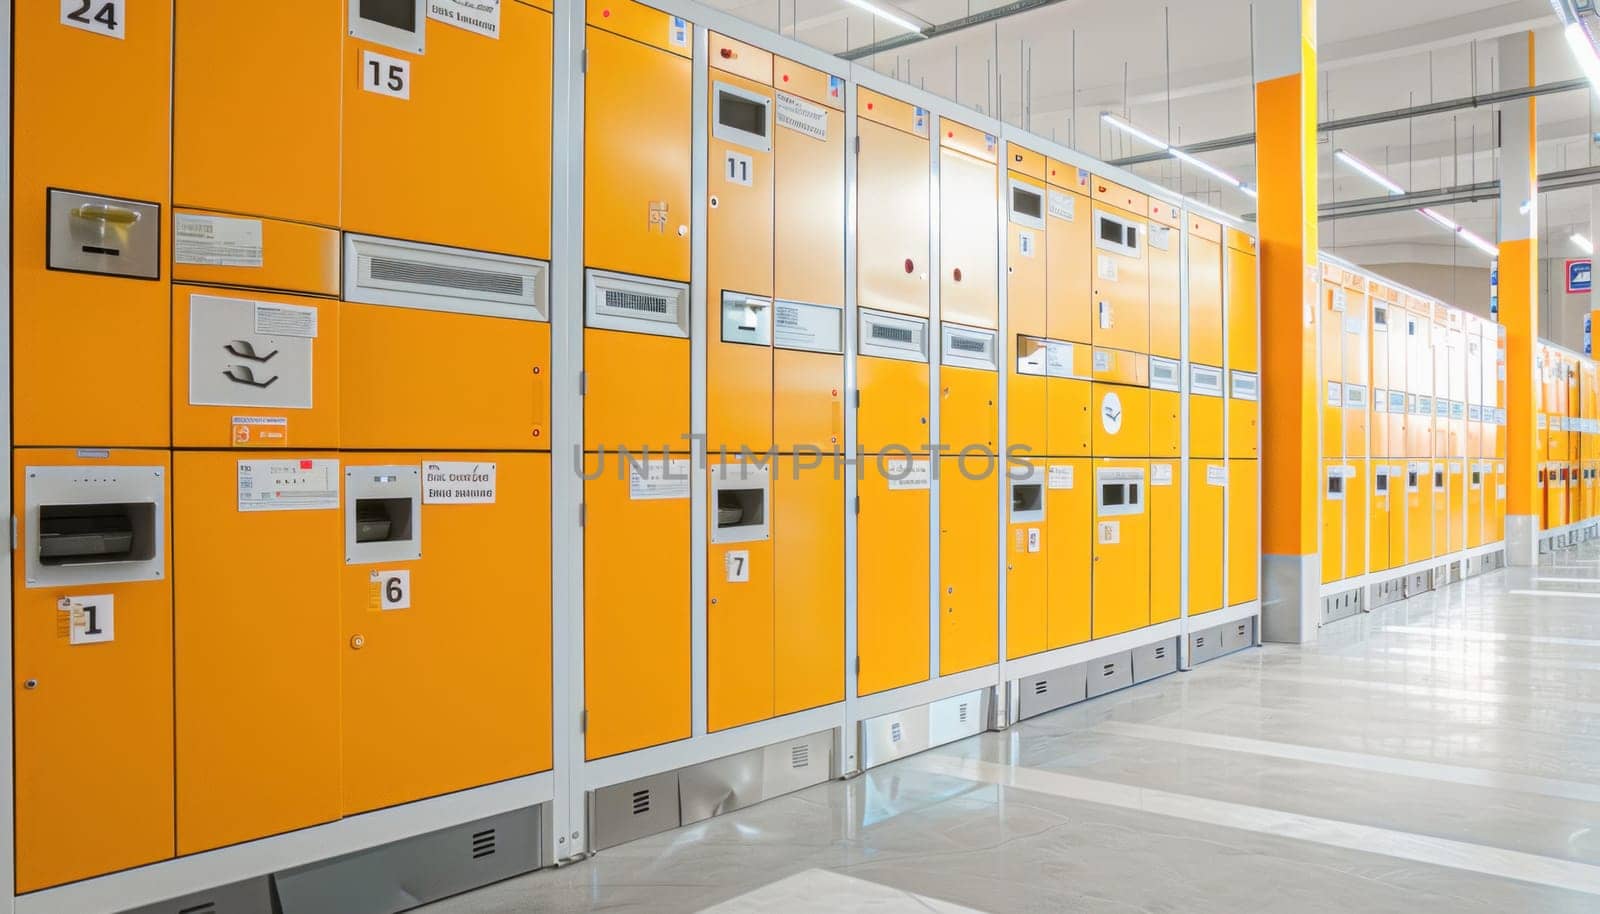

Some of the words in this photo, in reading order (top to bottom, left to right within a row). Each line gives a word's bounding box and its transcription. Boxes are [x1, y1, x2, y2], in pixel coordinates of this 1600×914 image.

[67, 0, 118, 30] 24
[368, 60, 403, 92] 15
[728, 157, 747, 181] 11
[734, 557, 745, 577] 7
[386, 576, 403, 603] 6
[82, 605, 103, 635] 1
